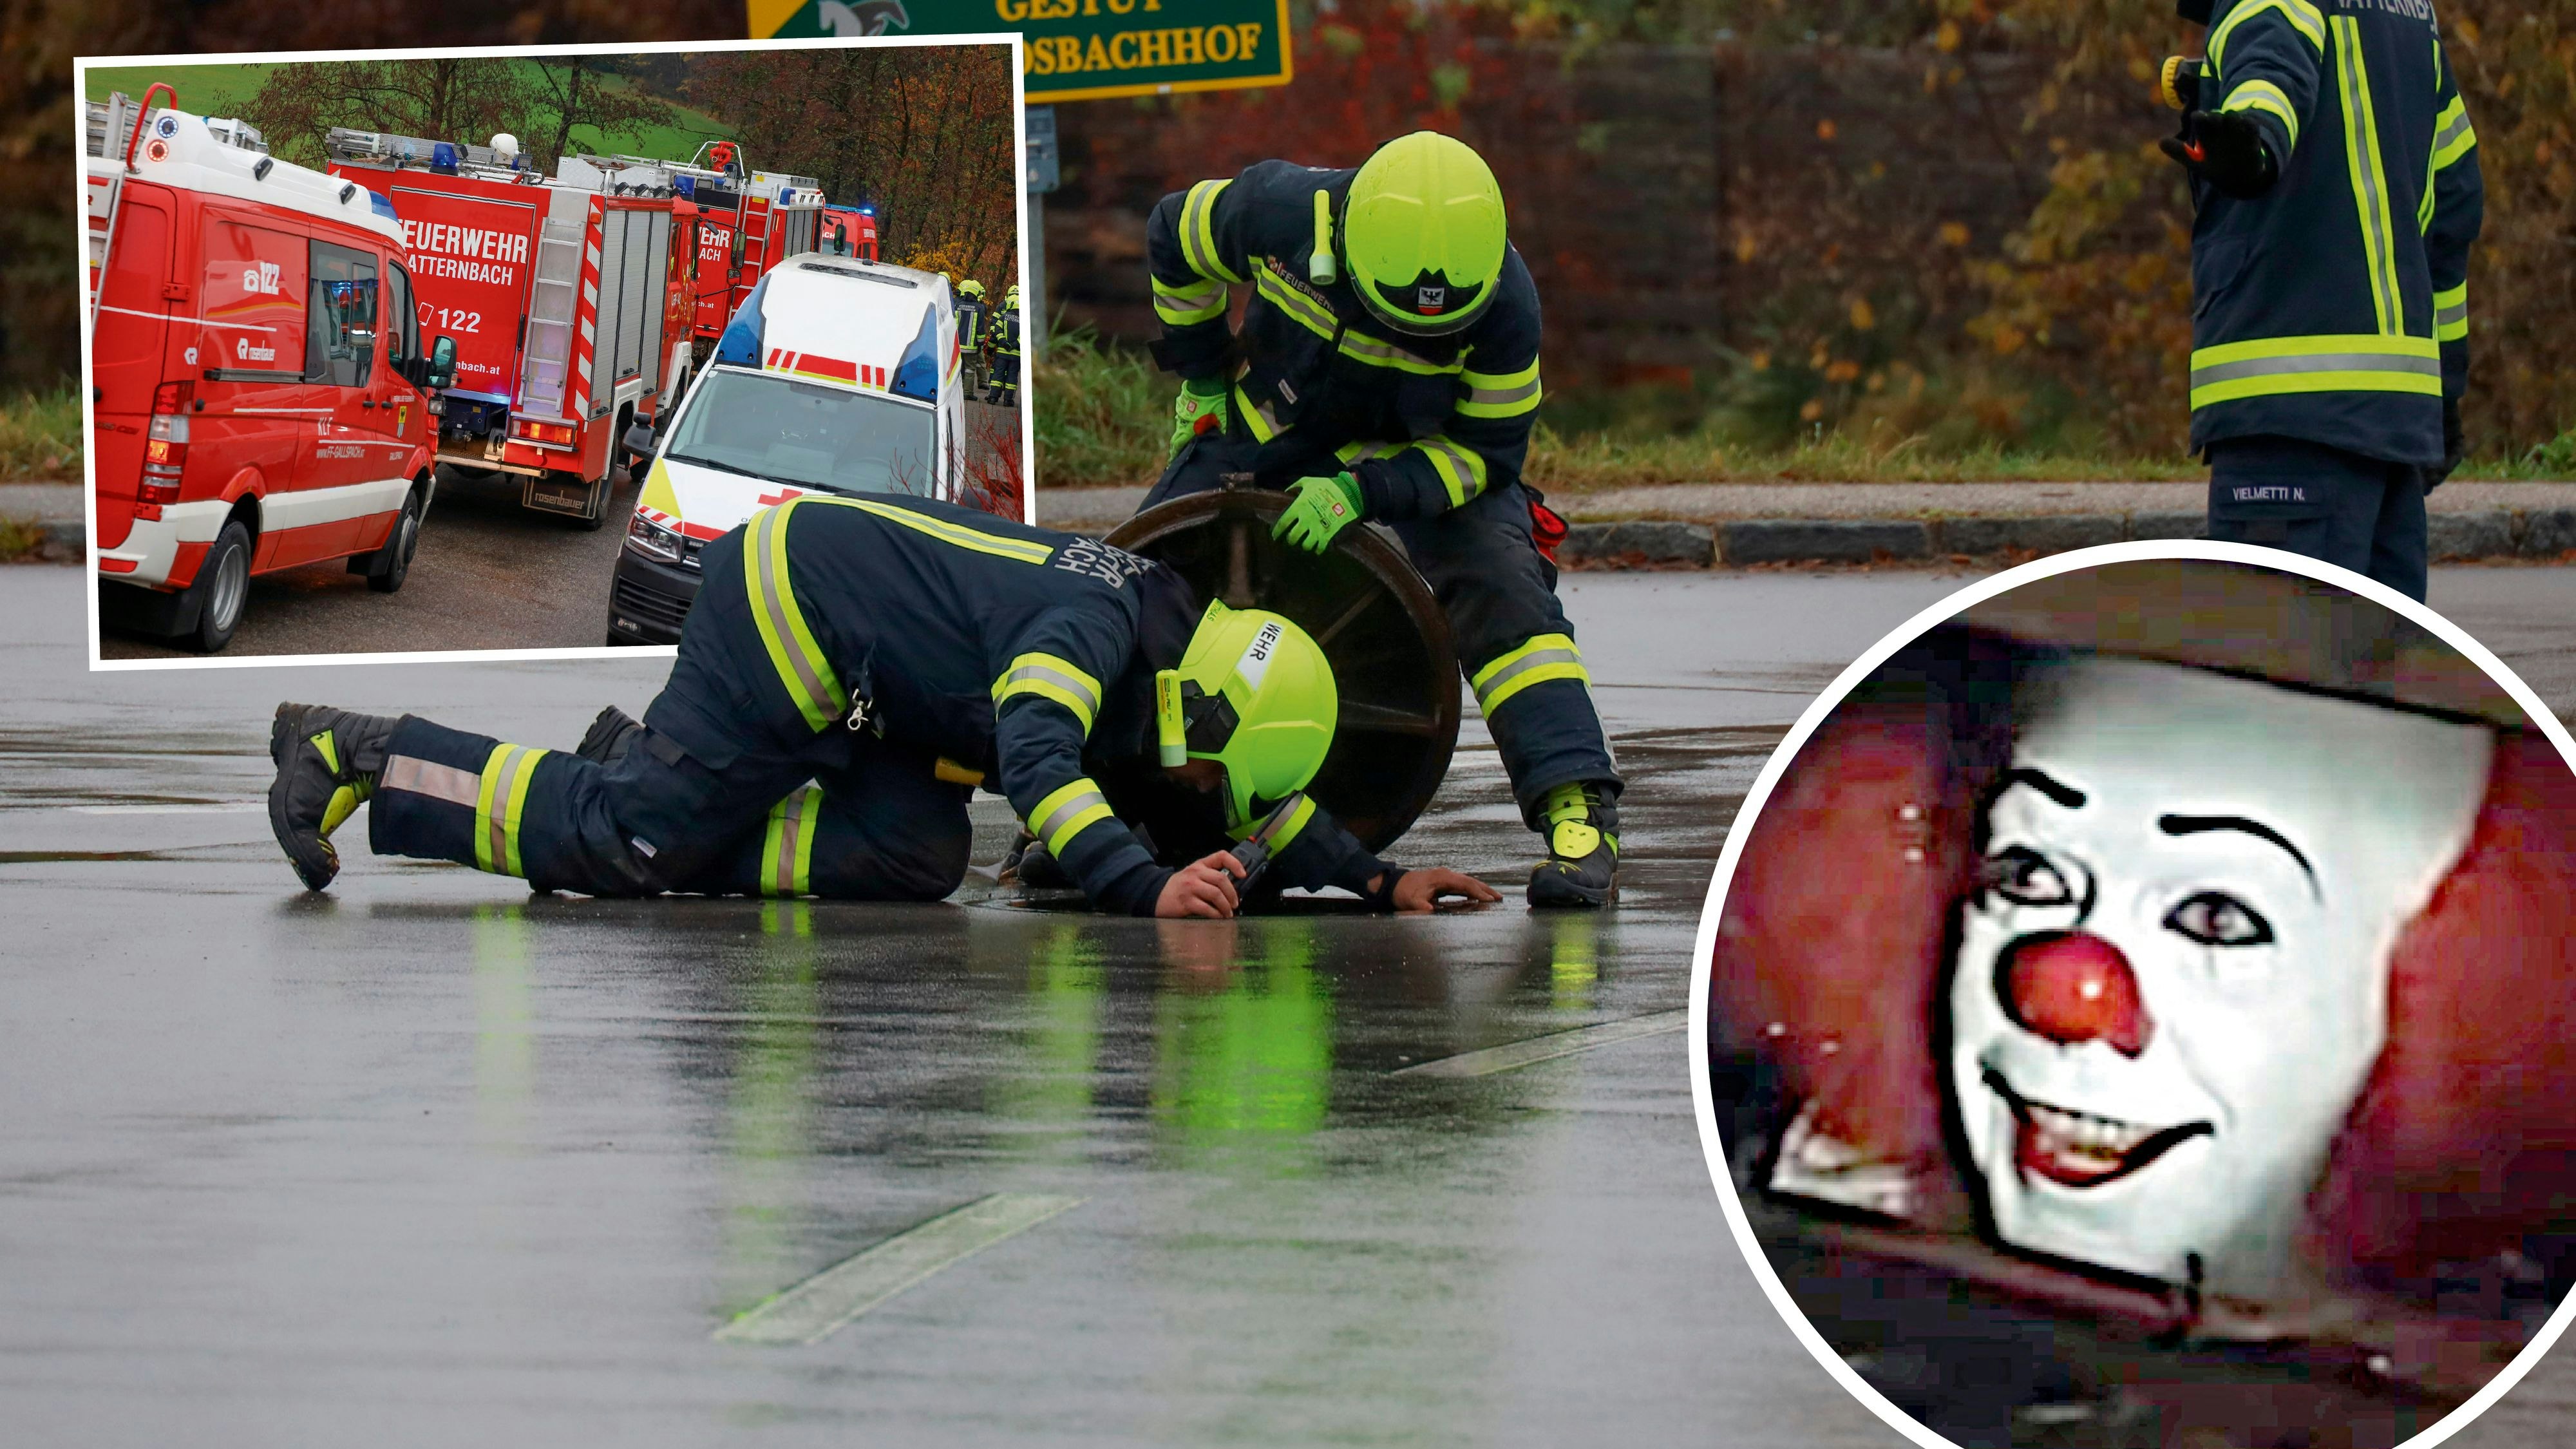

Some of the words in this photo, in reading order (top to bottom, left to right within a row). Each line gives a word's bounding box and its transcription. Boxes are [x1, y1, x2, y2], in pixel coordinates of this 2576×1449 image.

[1023, 23, 1262, 76] SBACHHOF
[398, 218, 528, 264] EUERWEHR
[699, 227, 730, 248] EHR
[260, 261, 280, 295] 122
[405, 253, 513, 286] ATTERNBACH
[438, 308, 481, 334] 122
[317, 417, 333, 436] KLF
[535, 489, 585, 509] rosenbauer
[2233, 486, 2289, 501] VIELMETTI
[1249, 622, 1282, 661] WEHR
